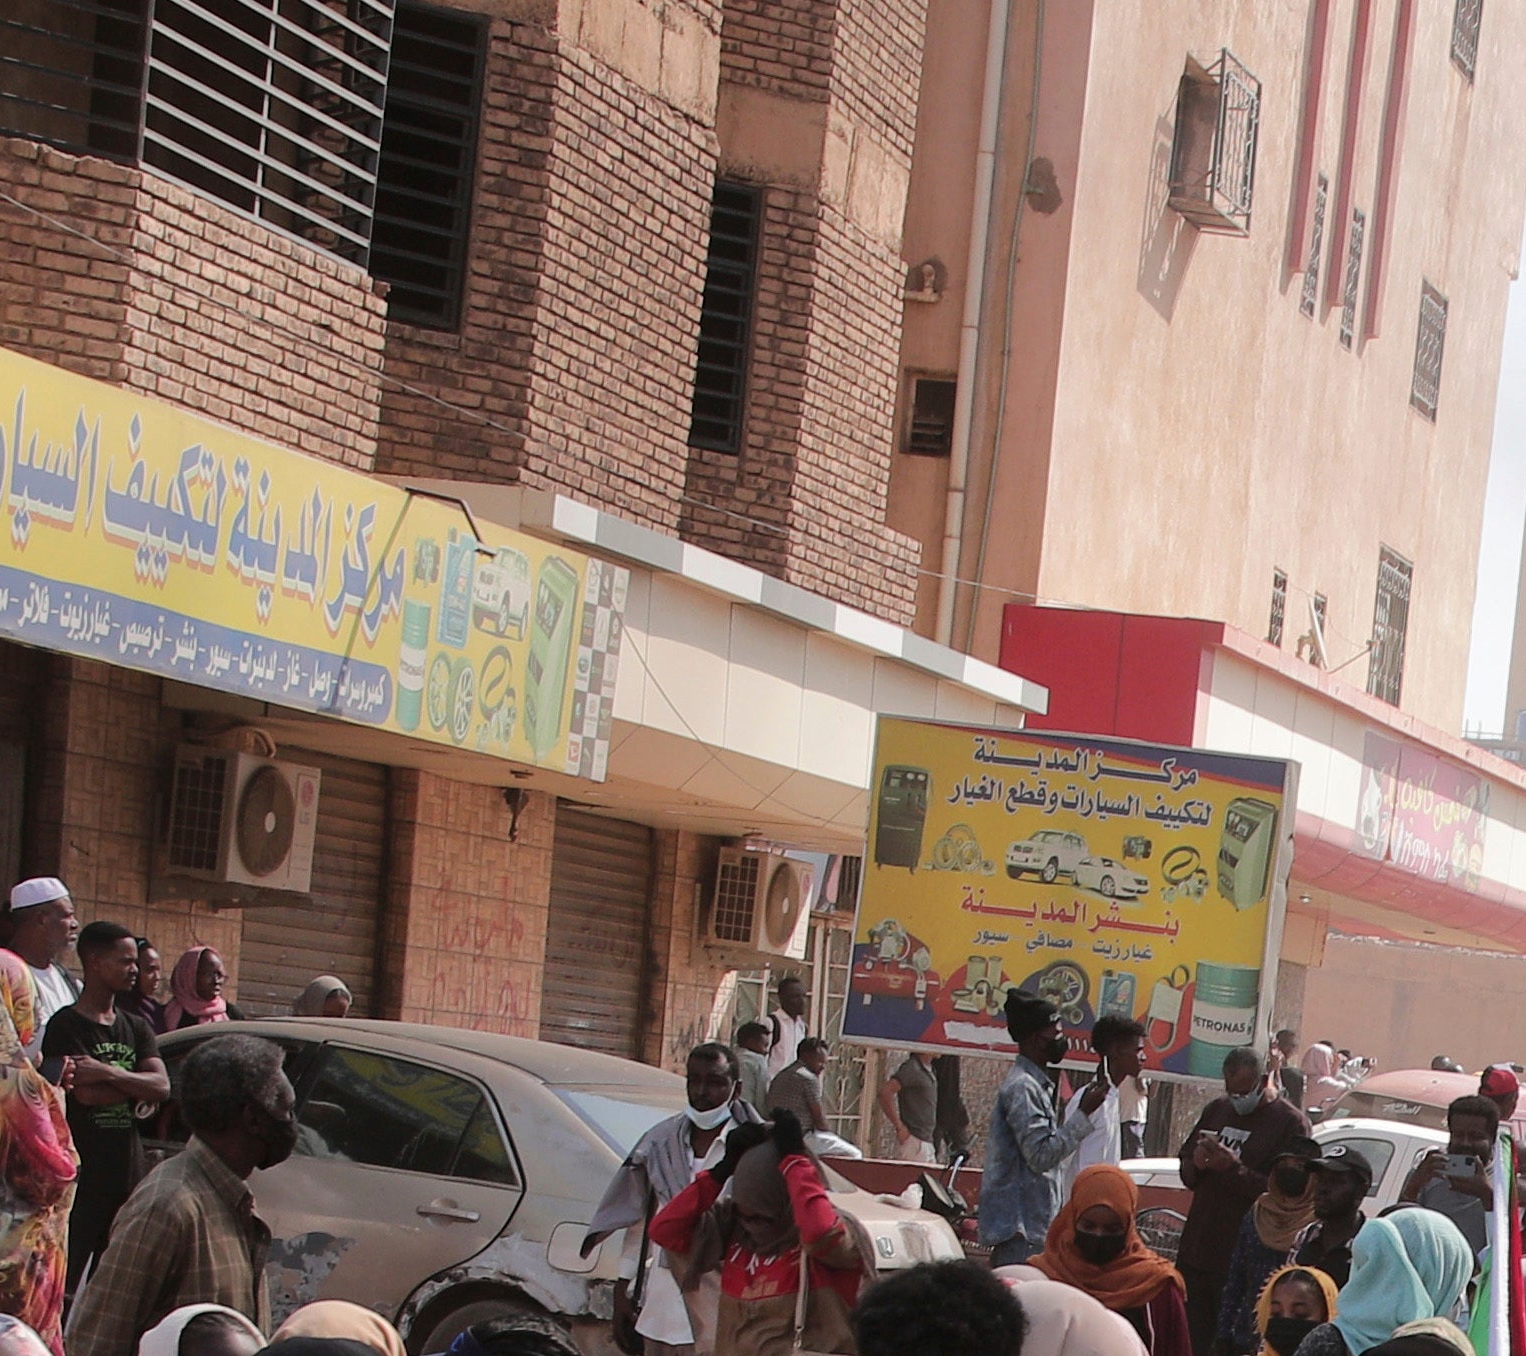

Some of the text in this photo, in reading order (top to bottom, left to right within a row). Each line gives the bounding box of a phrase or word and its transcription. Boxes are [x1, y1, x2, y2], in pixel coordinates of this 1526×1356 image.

[103, 411, 227, 589] لتكييف
[226, 452, 335, 627] المدينة
[324, 501, 408, 648] مركز
[973, 737, 1200, 792] مركز المدينة
[948, 774, 1213, 829] لتكييف السيارات وقطع الغيار
[960, 885, 1180, 944] بنشر المدينة
[972, 928, 1009, 946] سيور
[1025, 929, 1074, 955] مصافي
